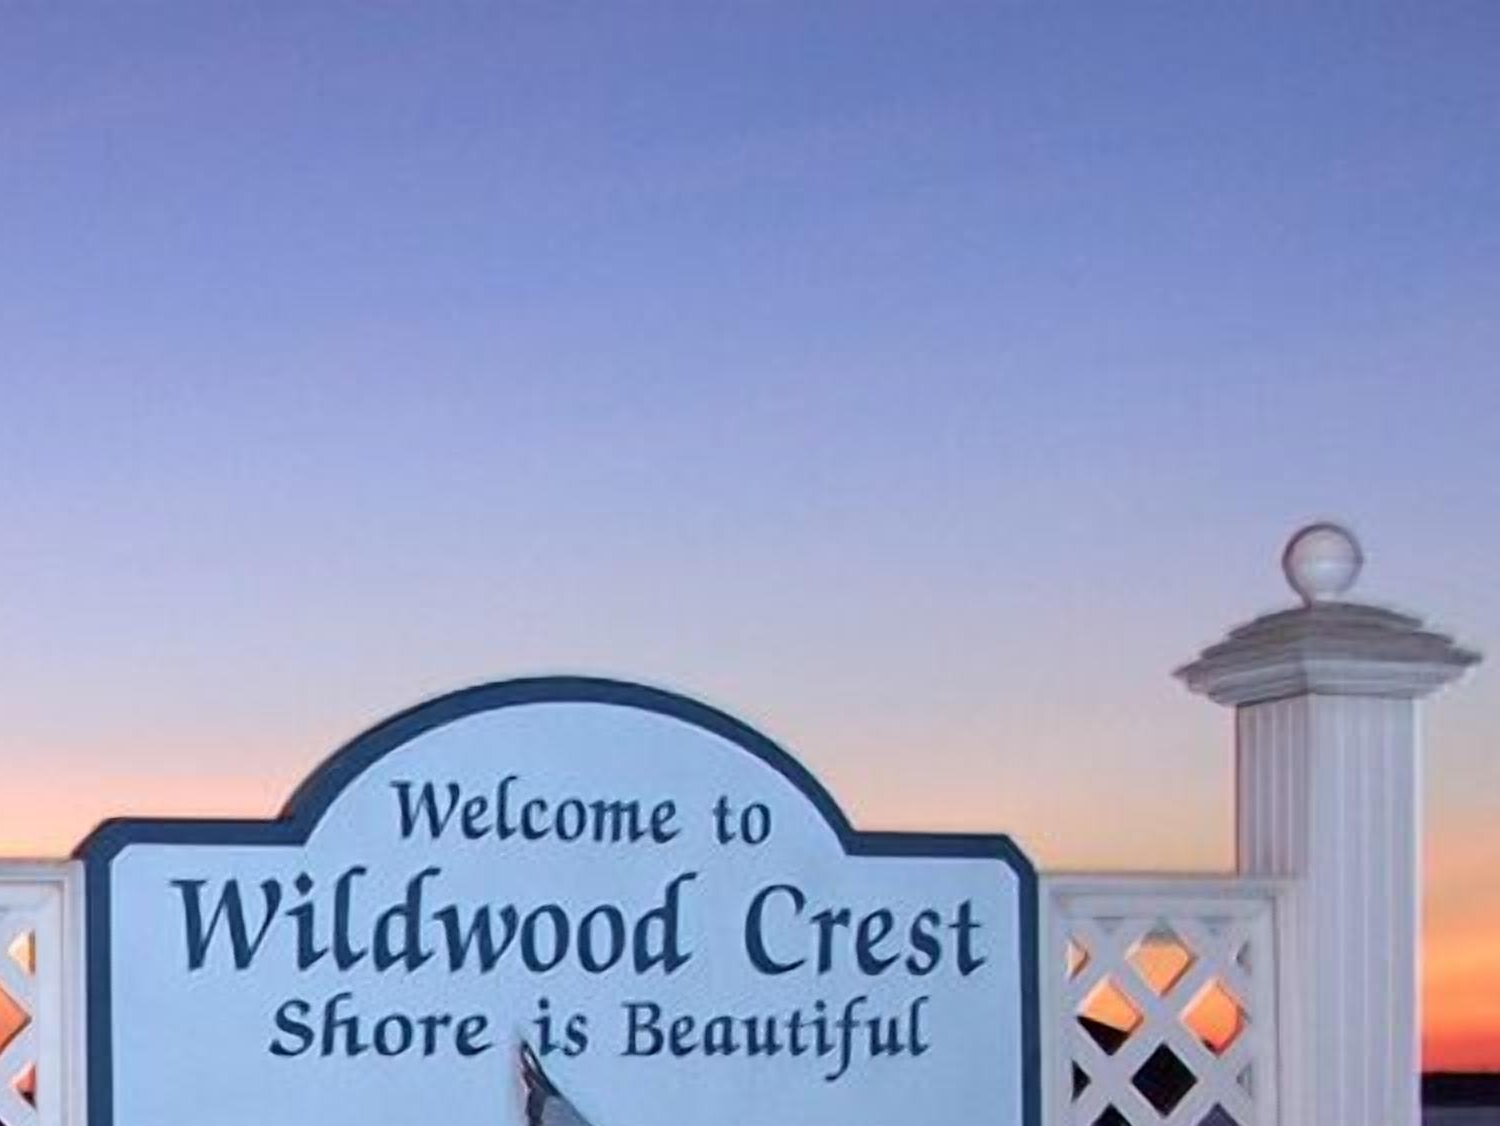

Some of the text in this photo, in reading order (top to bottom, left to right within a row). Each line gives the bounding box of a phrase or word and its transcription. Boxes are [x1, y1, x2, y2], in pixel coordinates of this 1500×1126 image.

[391, 776, 771, 846] Welcome to
[171, 866, 987, 977] Wildwood Crest
[269, 992, 930, 1082] Shore is Beautiful
